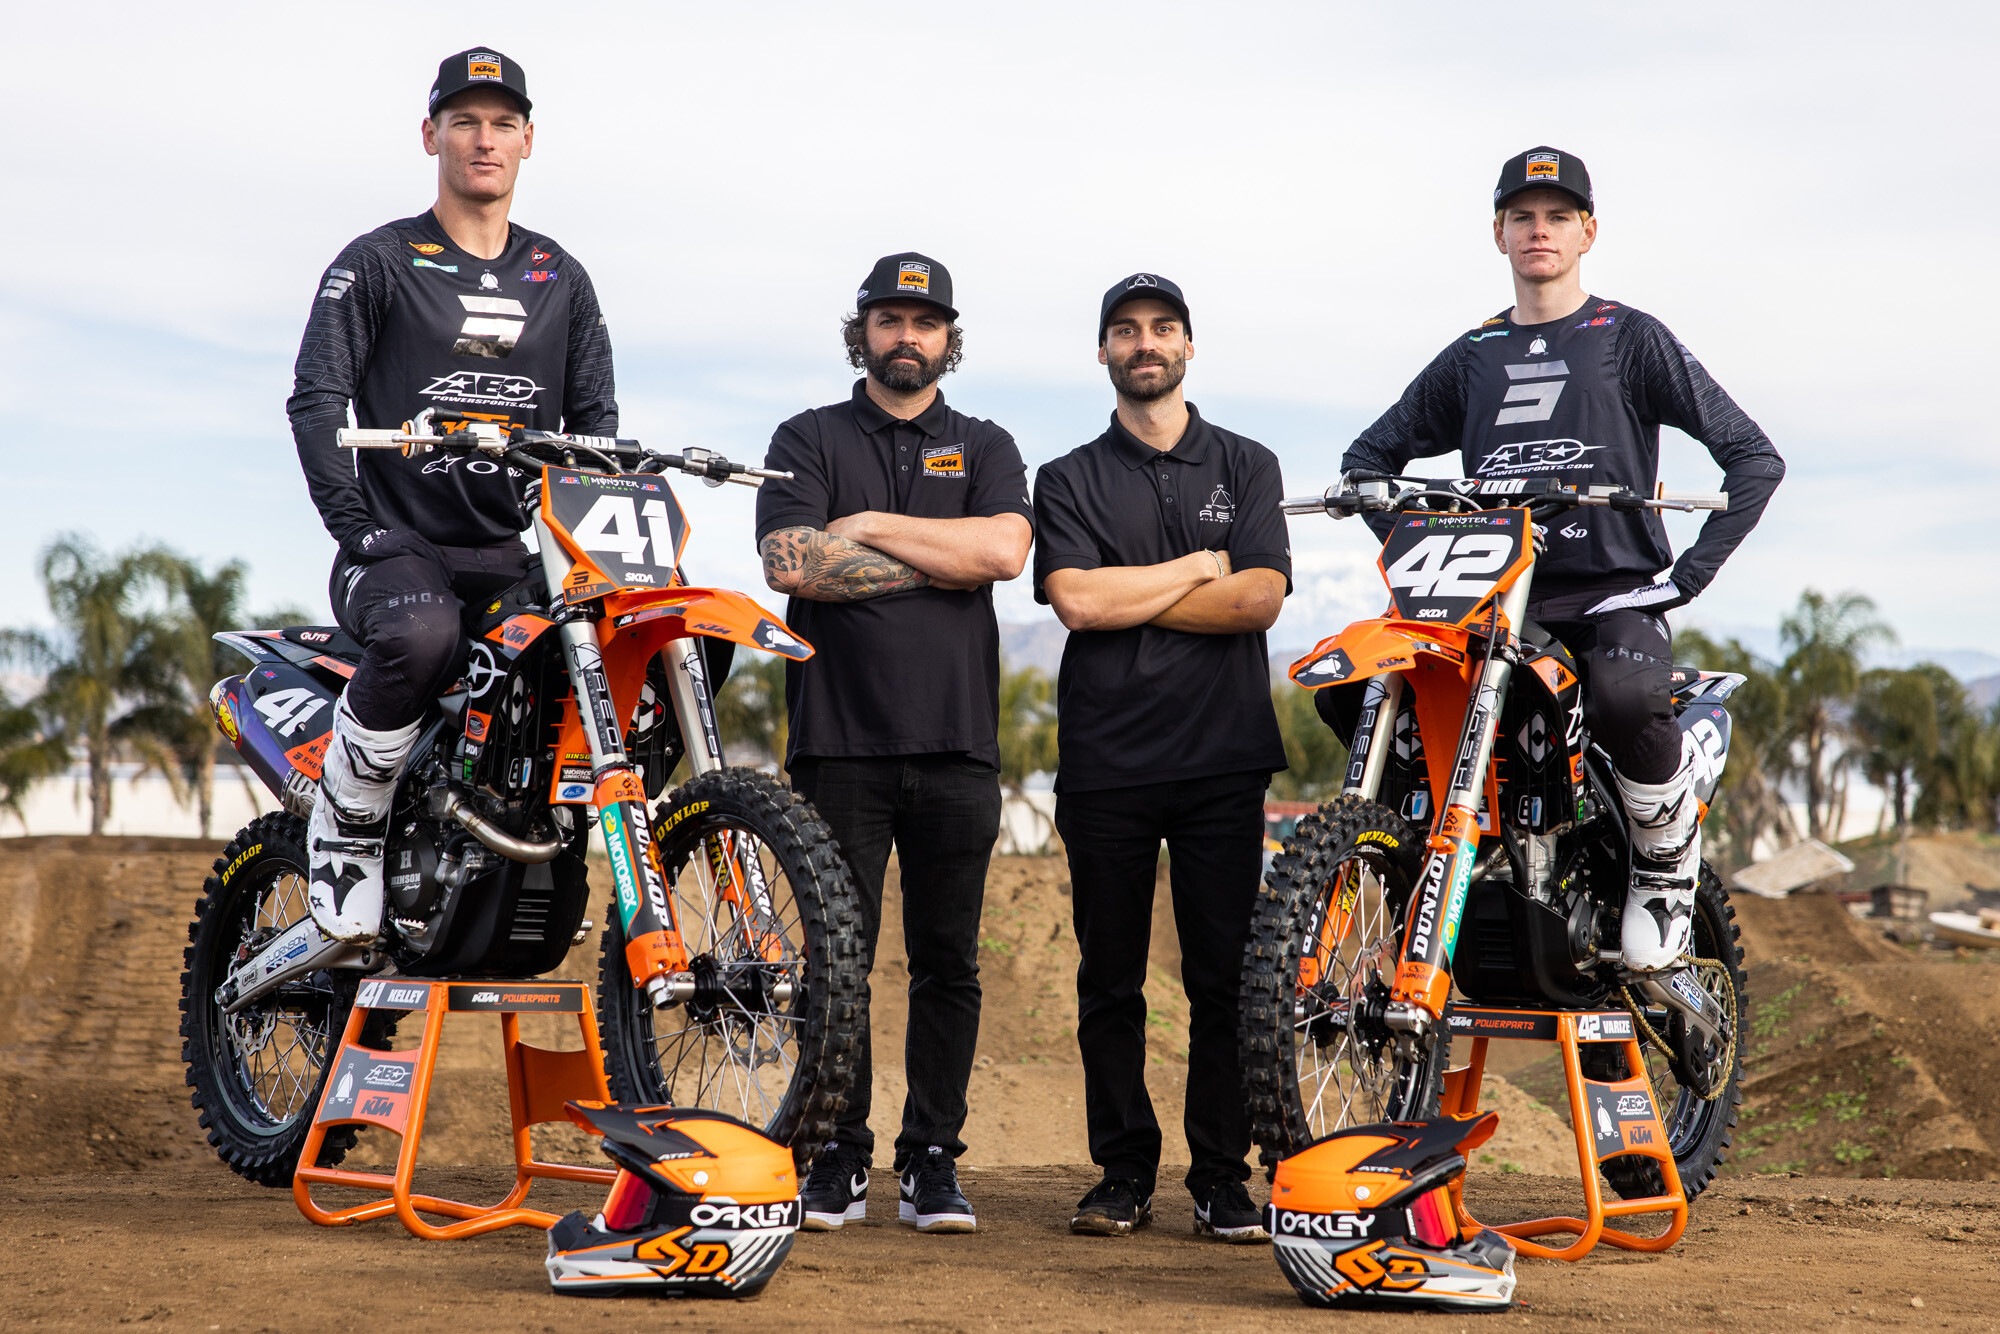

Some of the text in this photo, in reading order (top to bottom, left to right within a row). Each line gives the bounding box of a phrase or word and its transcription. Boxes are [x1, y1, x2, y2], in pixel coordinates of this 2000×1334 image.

[474, 65, 496, 74] KTM
[521, 270, 558, 282] AMA
[904, 275, 924, 284] KTM
[418, 371, 547, 401] AEO
[431, 395, 538, 409] POWERSPORTS.COM
[931, 459, 958, 467] KTM
[1476, 438, 1607, 474] AEO
[925, 468, 947, 476] RACING
[1486, 463, 1594, 477] POWERSPORTS.COM
[591, 477, 639, 489] MONSTER
[1438, 516, 1488, 525] MONSTER
[572, 495, 675, 569] 41
[1386, 534, 1514, 598] 42
[625, 572, 656, 584] SKDA
[569, 585, 598, 595] SHOT
[388, 593, 444, 608] SHOT
[1415, 608, 1449, 618] SKDA
[300, 631, 331, 642] GUTS
[499, 624, 531, 645] KTM
[692, 622, 733, 635] KTM
[1376, 657, 1408, 668] KTM
[1606, 648, 1655, 664] SHOT
[1549, 666, 1568, 690] KTM
[253, 687, 329, 738] 41
[655, 800, 710, 841] DUNLOP
[1355, 831, 1399, 848] DUNLOP
[221, 843, 263, 887] DUNLOP
[608, 832, 639, 912] MOTOREX
[630, 805, 670, 927] DUNLOP
[391, 872, 421, 883] HINSON
[1448, 847, 1475, 924] MOTOREX
[1413, 853, 1448, 959] DUNLO
[355, 981, 424, 1008] 41 KELLEY
[1578, 1014, 1630, 1041] 42 VARIZE
[364, 1064, 411, 1082] AEO
[361, 1096, 394, 1117] KTM
[1617, 1095, 1650, 1113] AEO
[1629, 1126, 1653, 1144] KTM
[690, 1202, 793, 1229] OAKLEY
[1281, 1211, 1376, 1238] OAKLEY
